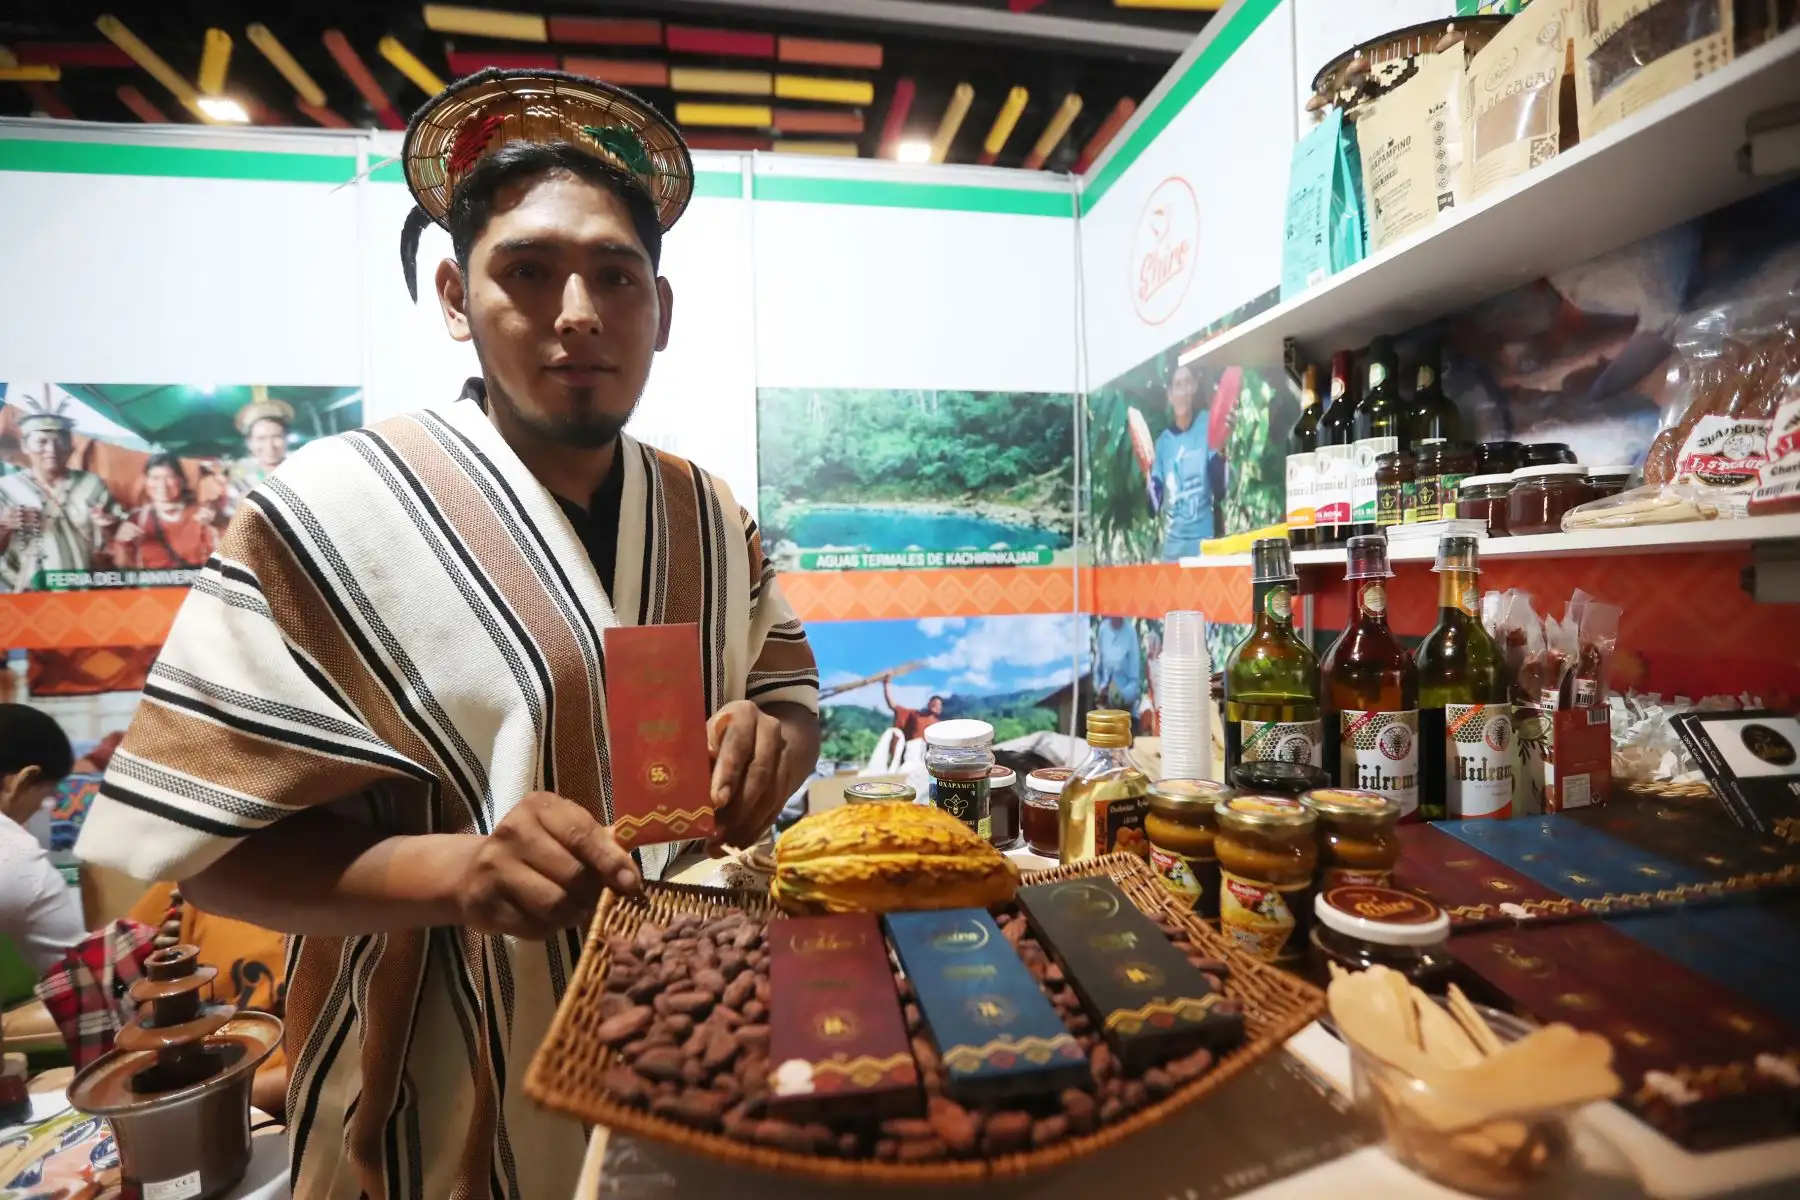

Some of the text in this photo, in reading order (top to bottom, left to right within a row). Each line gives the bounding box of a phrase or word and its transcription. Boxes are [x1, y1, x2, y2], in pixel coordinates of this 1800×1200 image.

[817, 553, 860, 568] AGUAS
[862, 552, 925, 567] TERMALES
[927, 552, 944, 567] DE
[938, 780, 976, 789] OXAPAMPA
